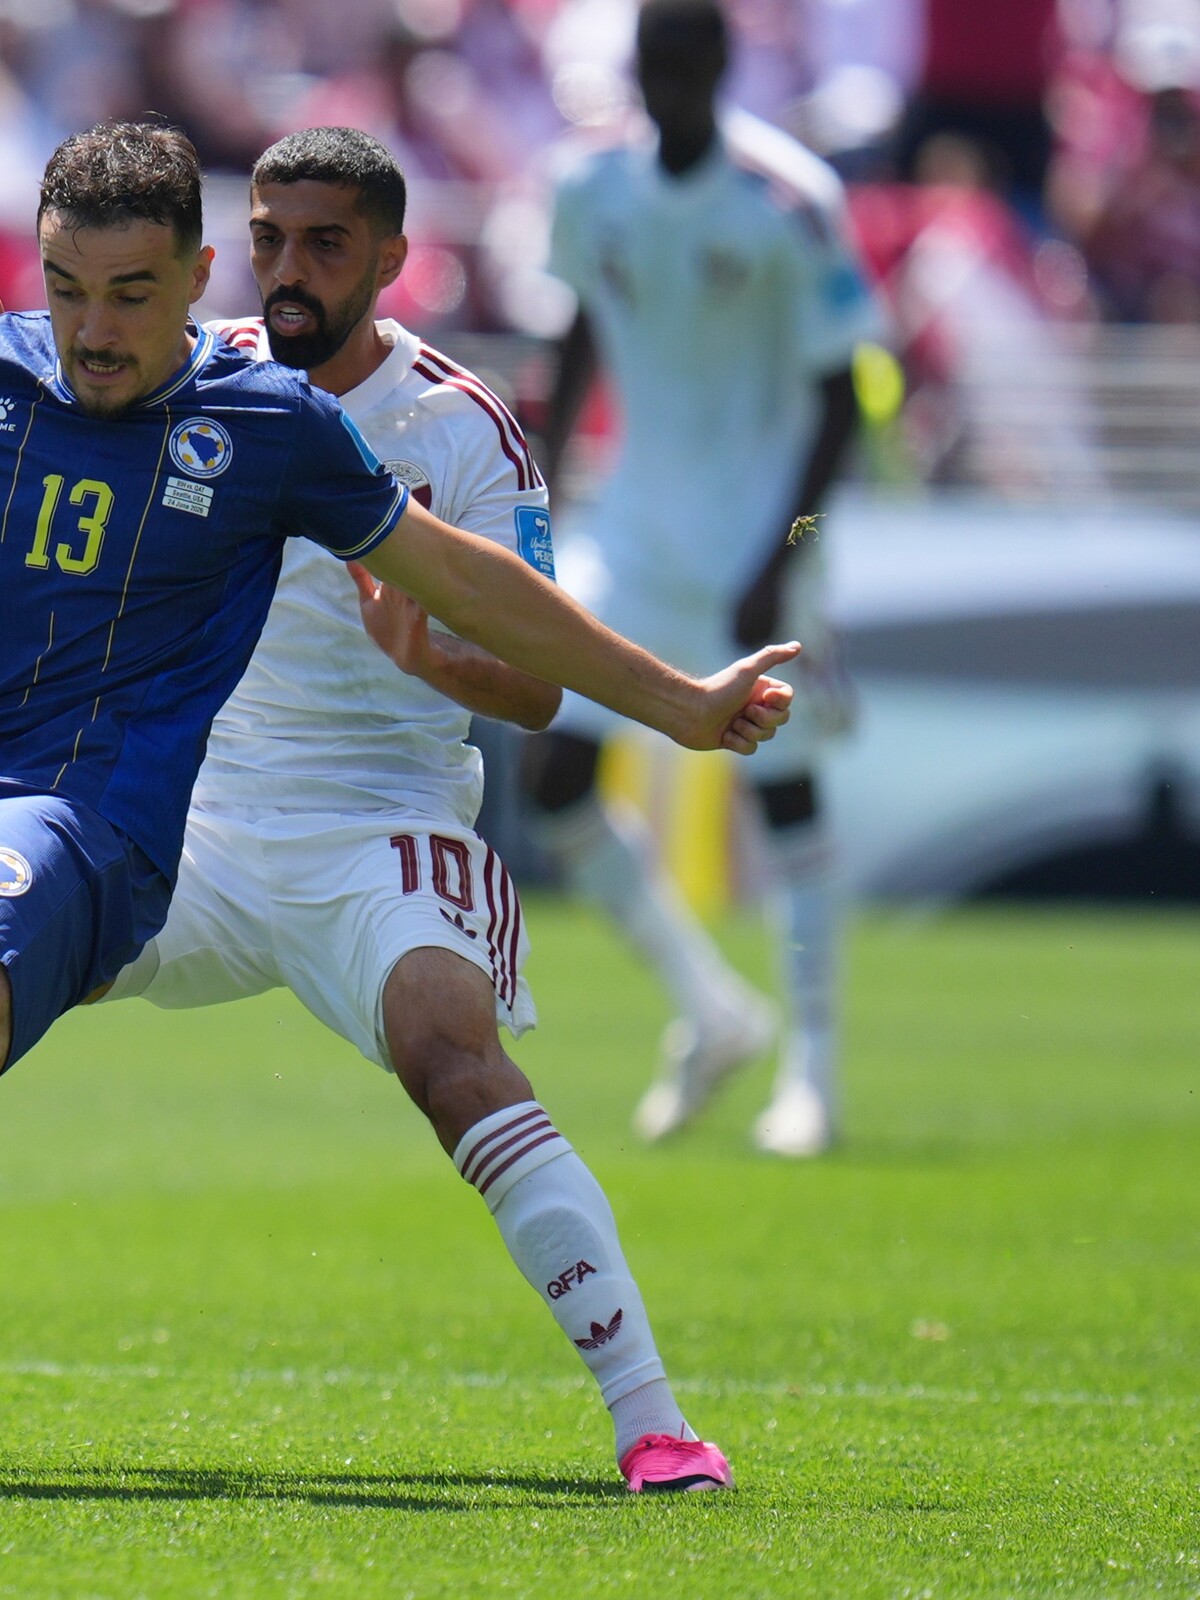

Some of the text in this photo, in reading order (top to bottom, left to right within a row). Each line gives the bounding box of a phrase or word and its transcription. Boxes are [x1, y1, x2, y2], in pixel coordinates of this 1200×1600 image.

[25, 474, 115, 576] 13
[390, 834, 477, 914] 10
[547, 1259, 597, 1300] QFA
